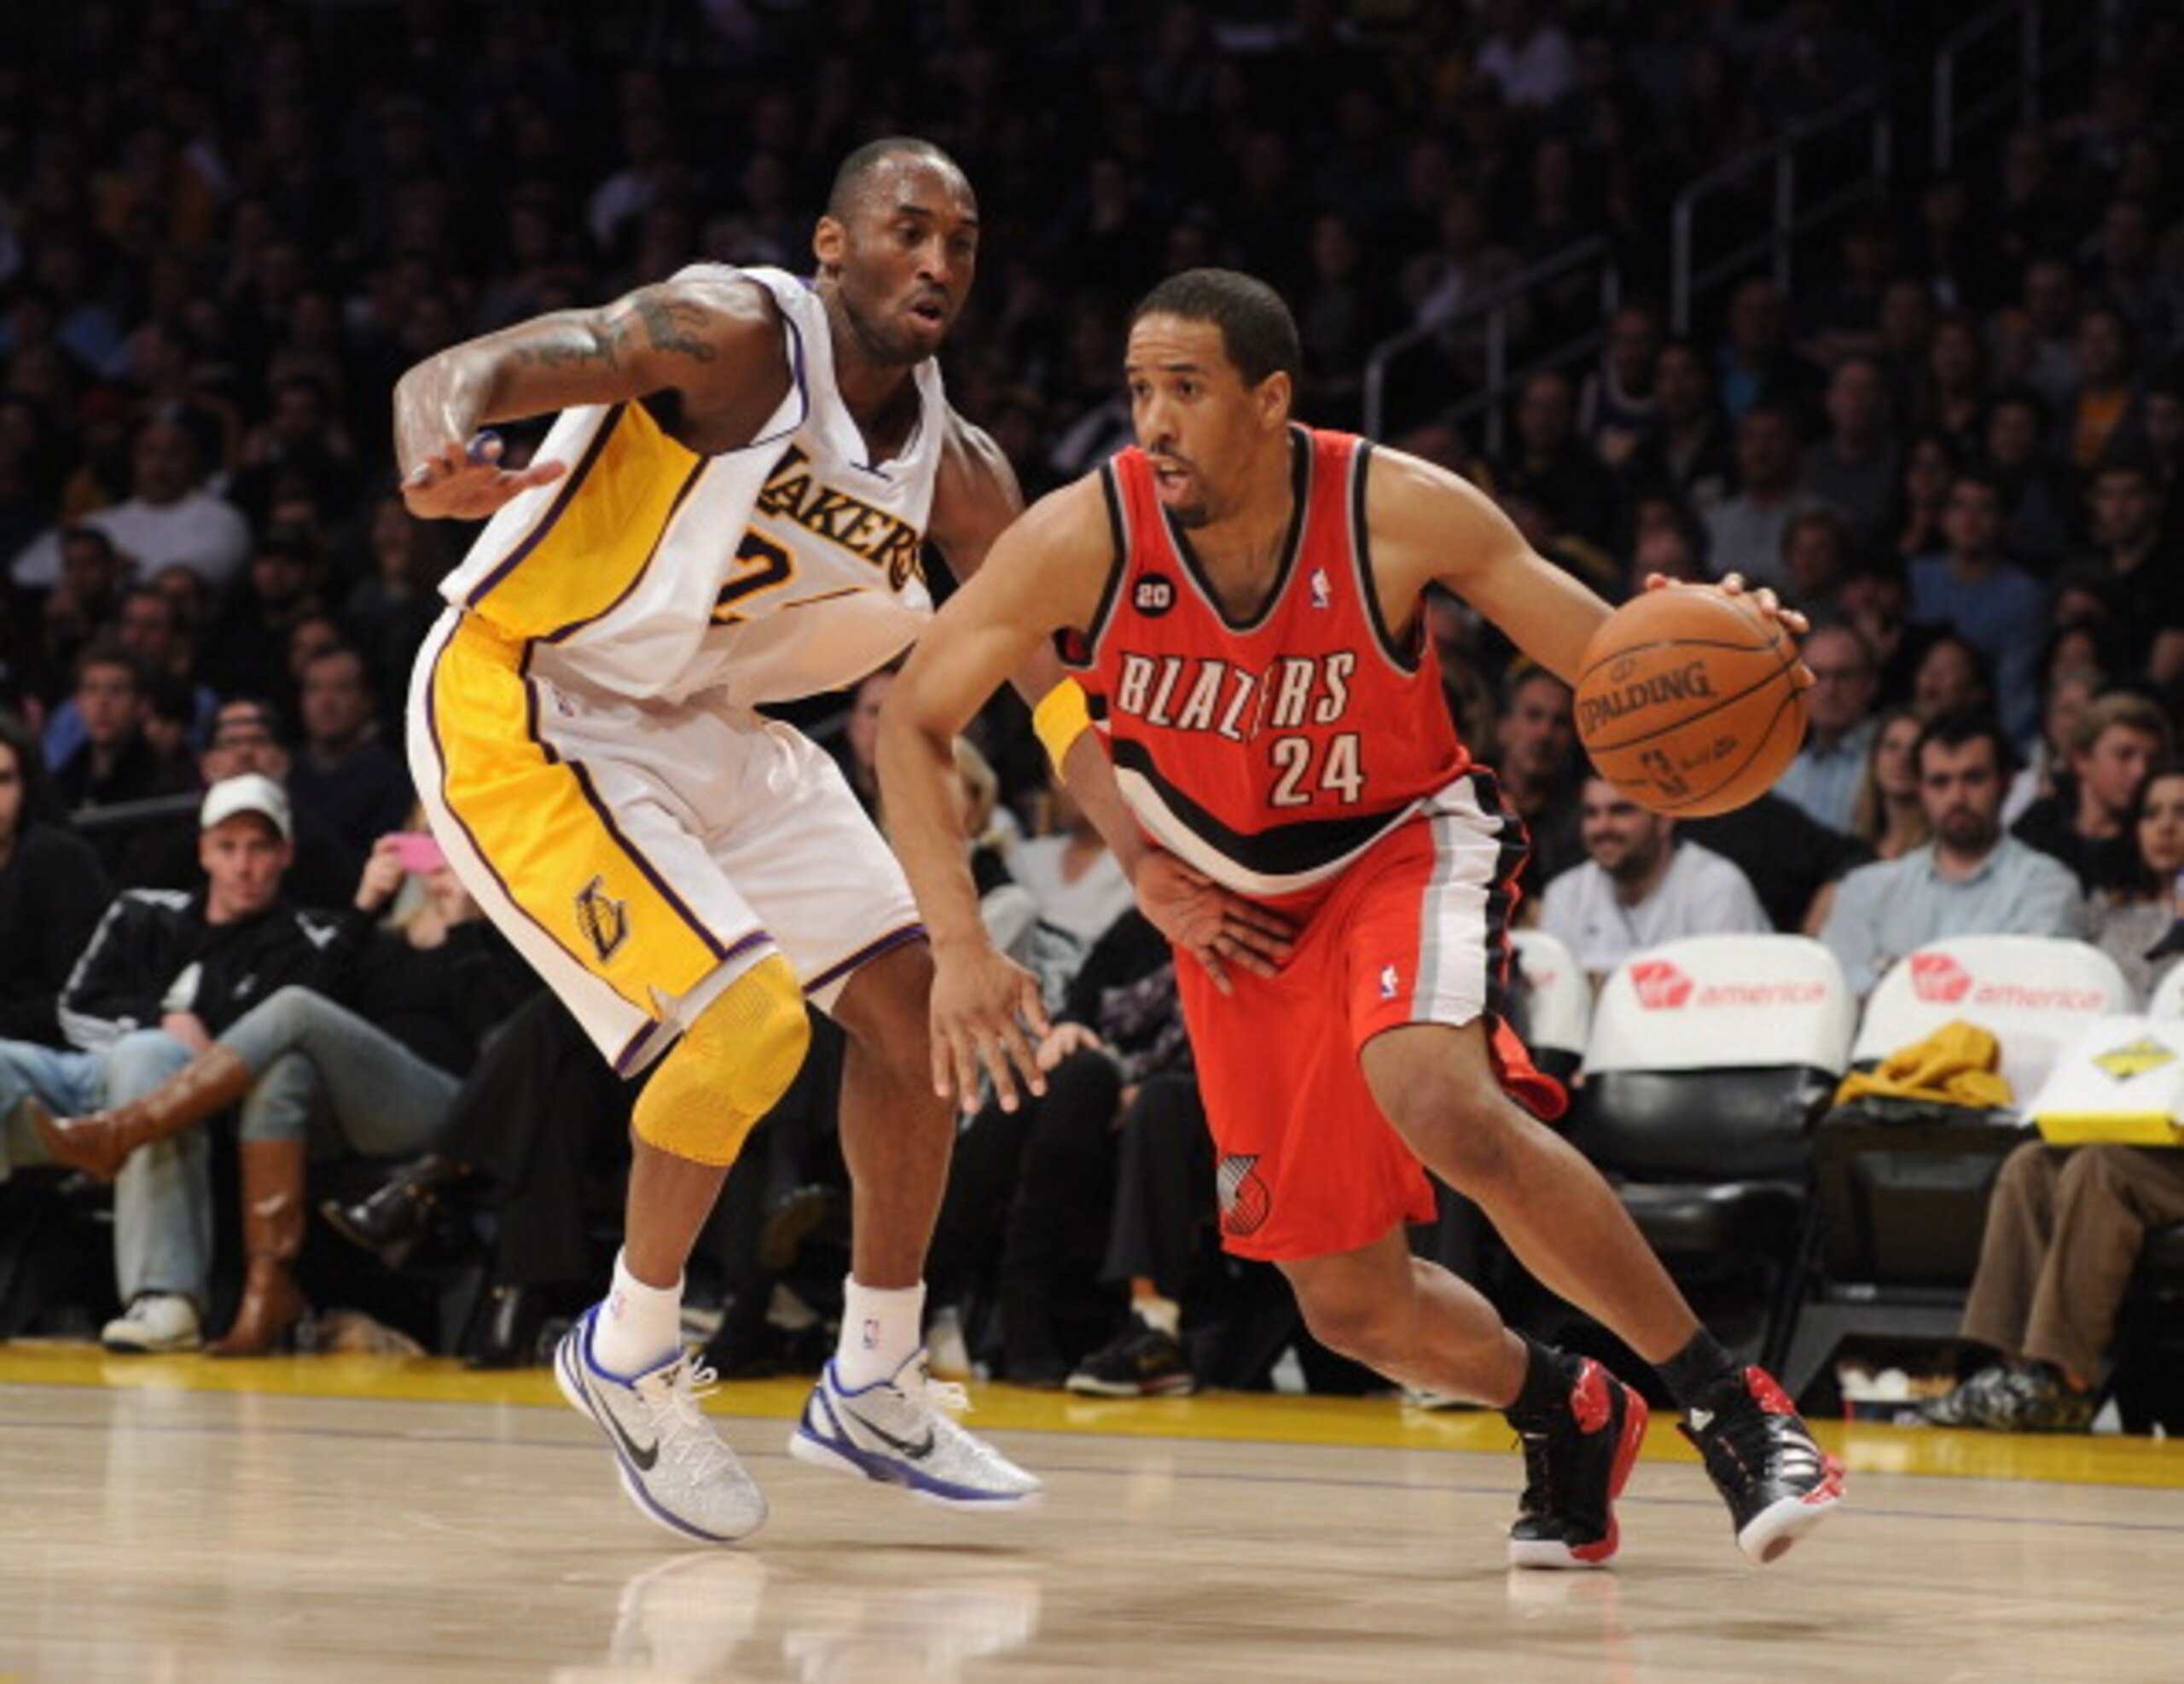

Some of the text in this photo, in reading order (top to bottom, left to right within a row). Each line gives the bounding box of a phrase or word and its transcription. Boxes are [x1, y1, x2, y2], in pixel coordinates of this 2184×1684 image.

[1136, 584, 1170, 608] 20
[1116, 650, 1355, 740] BLAZRS
[1270, 735, 1365, 806] 24
